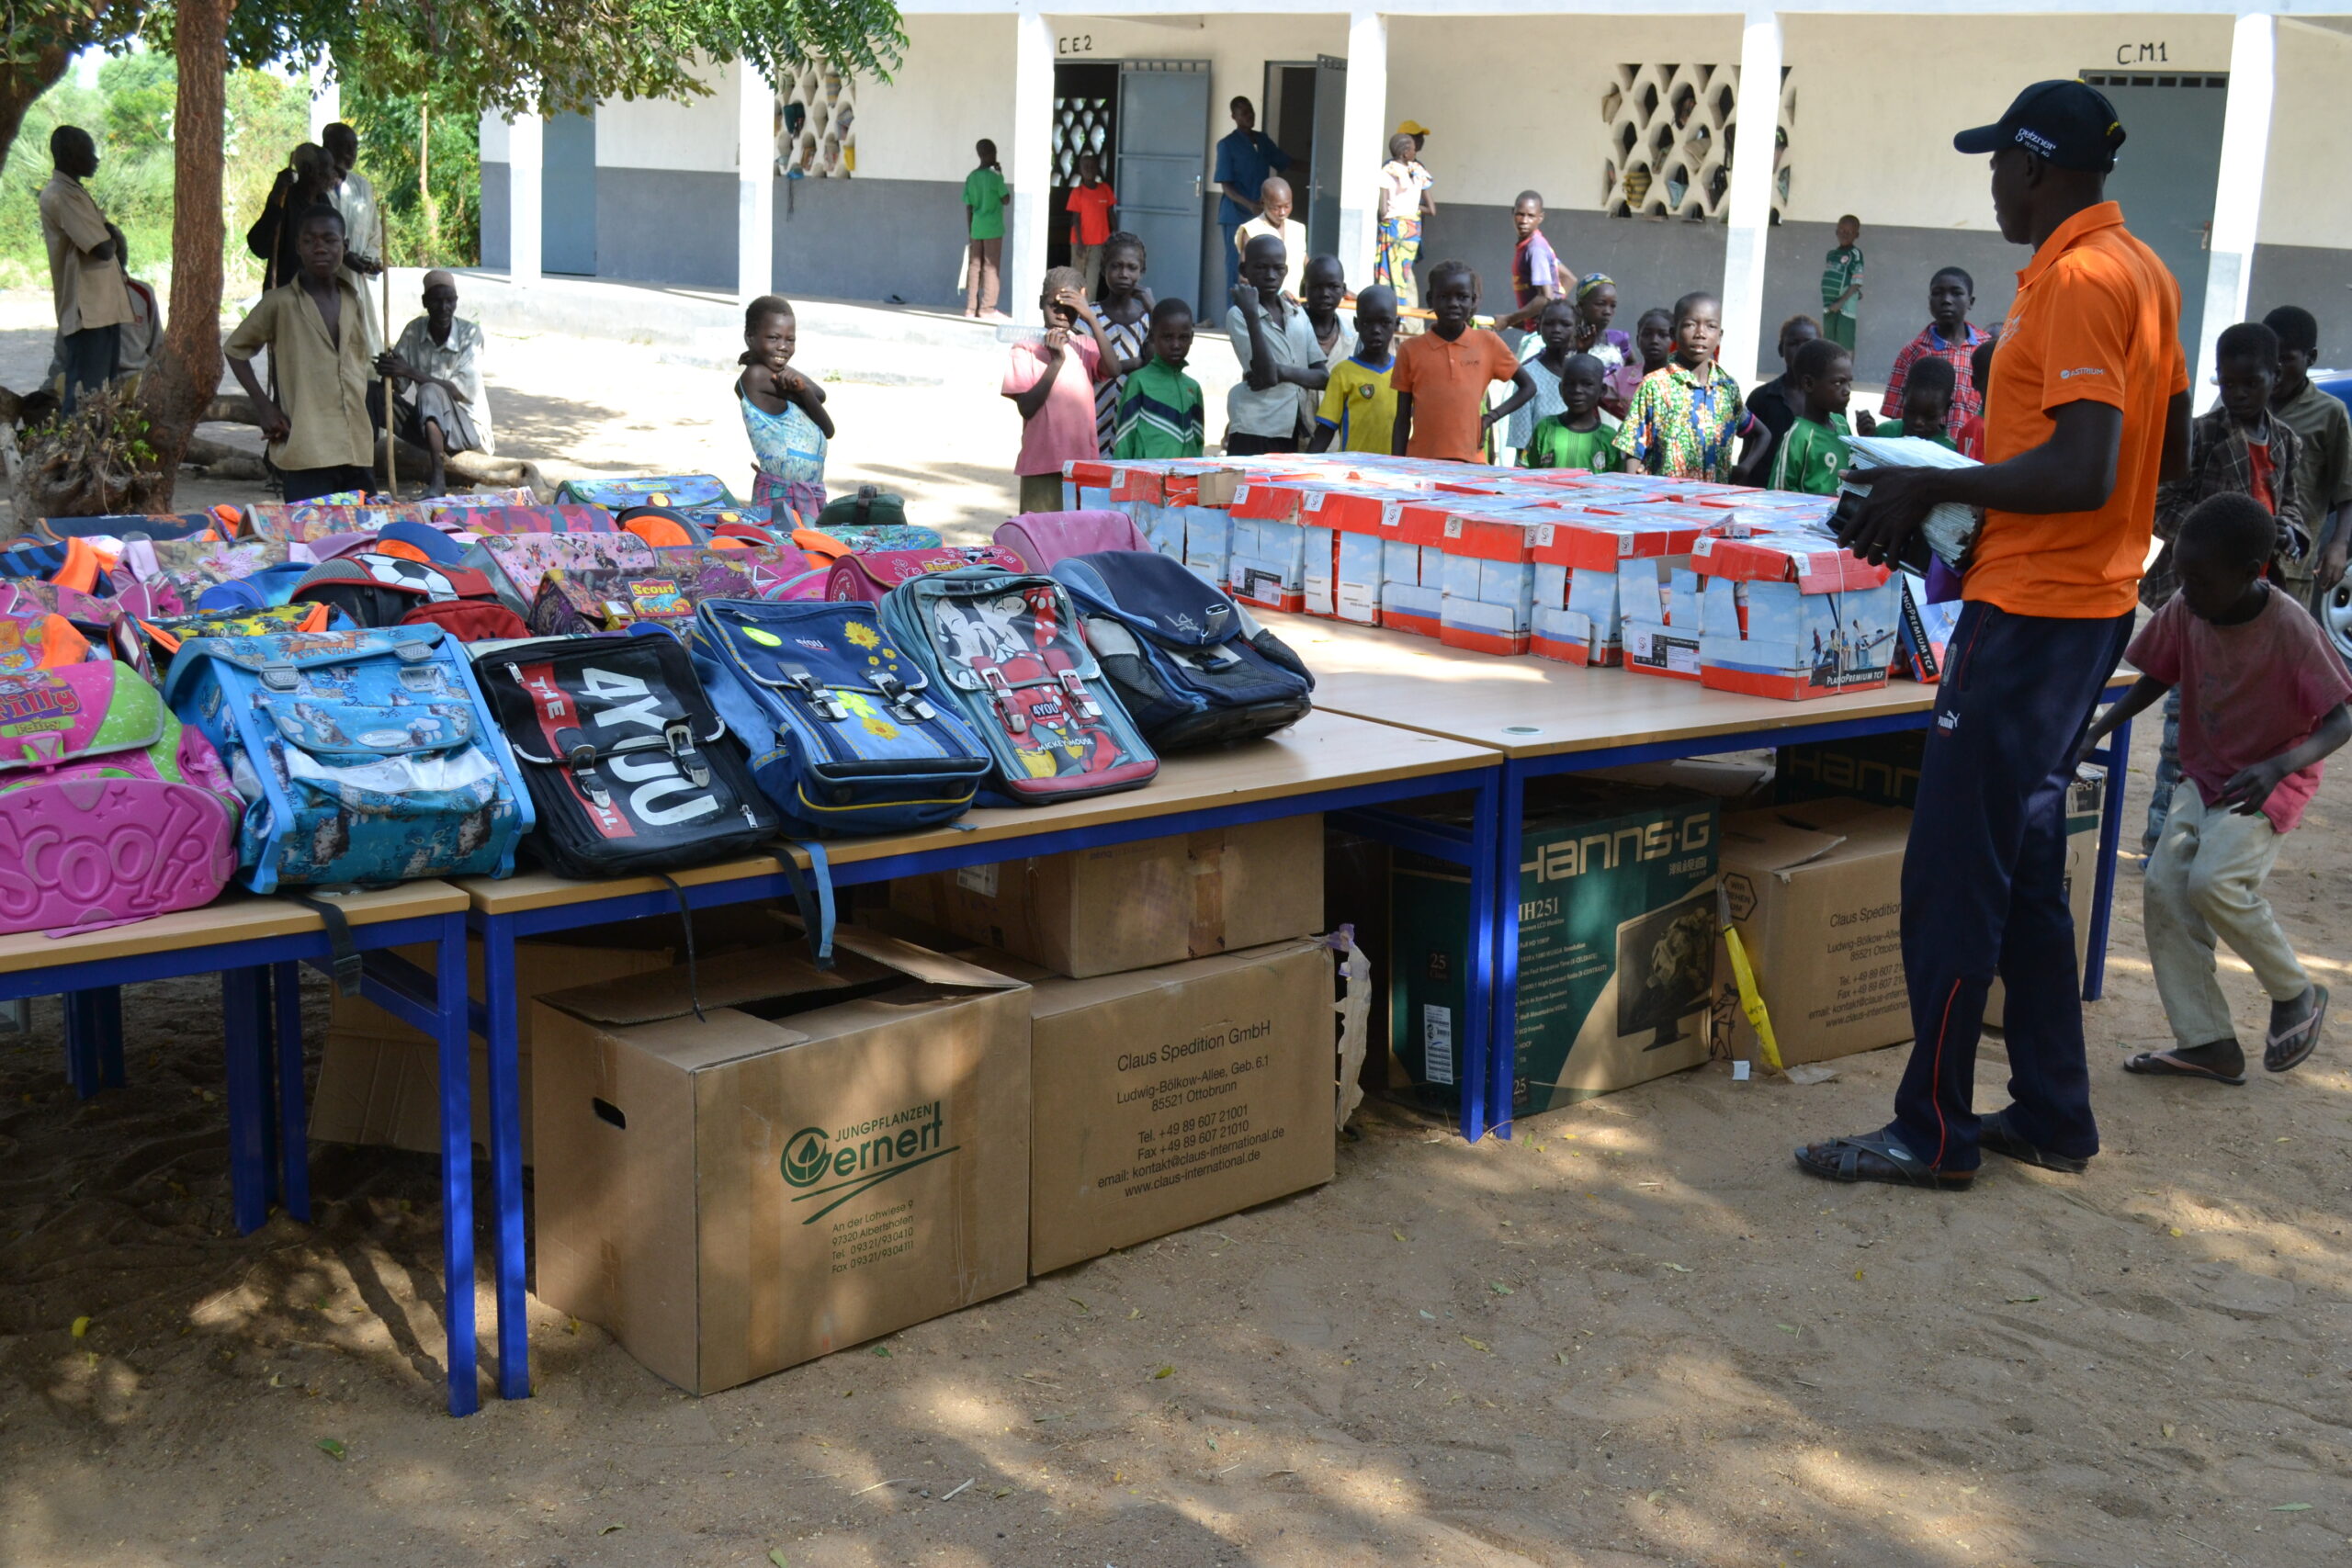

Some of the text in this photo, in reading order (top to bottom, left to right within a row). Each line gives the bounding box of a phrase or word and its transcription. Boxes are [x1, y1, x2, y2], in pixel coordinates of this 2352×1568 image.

[1058, 34, 1092, 54] C.E.2
[2117, 41, 2168, 65] C.M.1
[1824, 452, 1838, 475] 9
[631, 583, 676, 595] Scout
[1923, 654, 1934, 670] TCF
[1874, 671, 1884, 681] TCF
[530, 676, 566, 719] THE
[1033, 703, 1059, 716] 4YOU
[17, 719, 61, 736] Fairy
[1037, 739, 1067, 751] MICKEY
[1829, 911, 1858, 928] Claus
[1430, 953, 1447, 970] 25
[1117, 1020, 1272, 1072] Claus Spedition GmbH
[1116, 1067, 1228, 1104] Ludwig-Bölkow-Allee,
[1151, 1080, 1238, 1112] 85521 Ottobrunn
[1513, 1077, 1527, 1095] 25
[835, 1102, 933, 1143] JUNGPFLANZEN
[1138, 1103, 1249, 1145] Tel. +49 89 607 21001
[780, 1100, 944, 1189] Gernert
[1137, 1119, 1250, 1161] Fax +49 89 607 21010
[1098, 1126, 1285, 1189] email: kontakt@claus-international.de
[1125, 1149, 1261, 1198] www.claus-international.de
[831, 1199, 914, 1233] An der Lohwiese 9
[831, 1214, 914, 1247] 97320 Albertshofen
[831, 1262, 848, 1274] Fax
